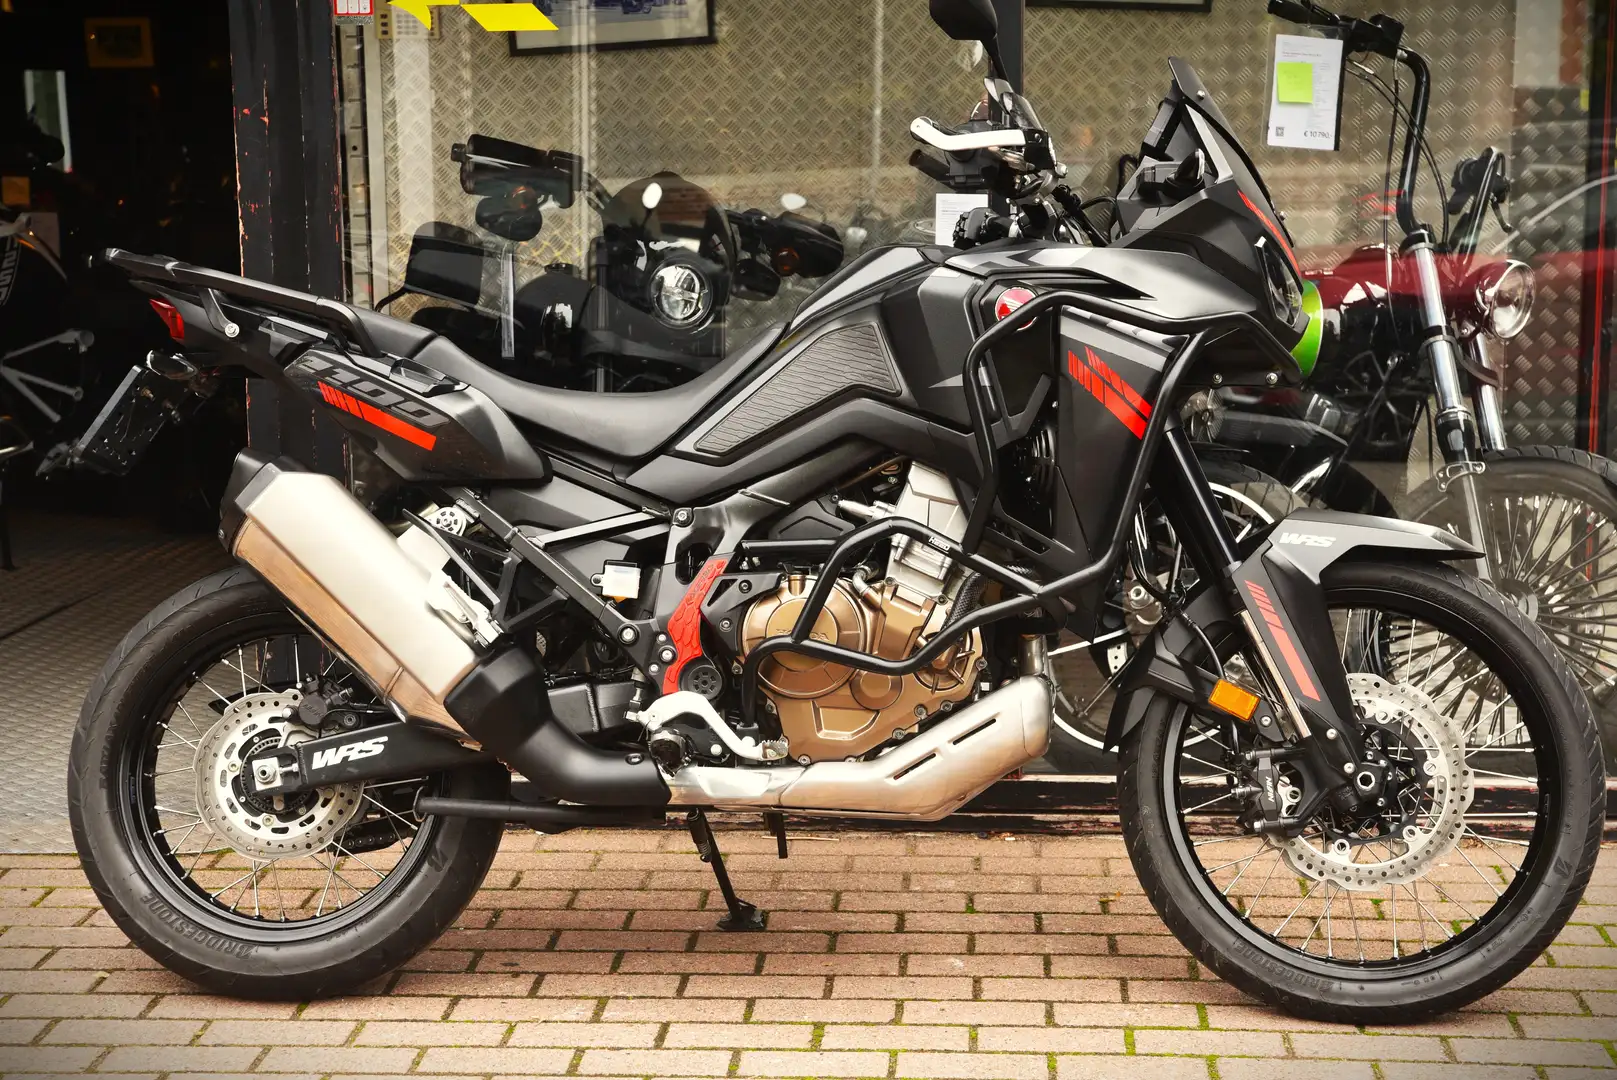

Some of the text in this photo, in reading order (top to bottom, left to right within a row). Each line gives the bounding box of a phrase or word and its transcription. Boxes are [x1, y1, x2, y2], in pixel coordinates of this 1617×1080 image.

[1279, 532, 1336, 548] WRS
[311, 735, 389, 770] WRS
[140, 893, 254, 961] BRIDGESTONE
[1233, 940, 1335, 994] BRIDGESTONE
